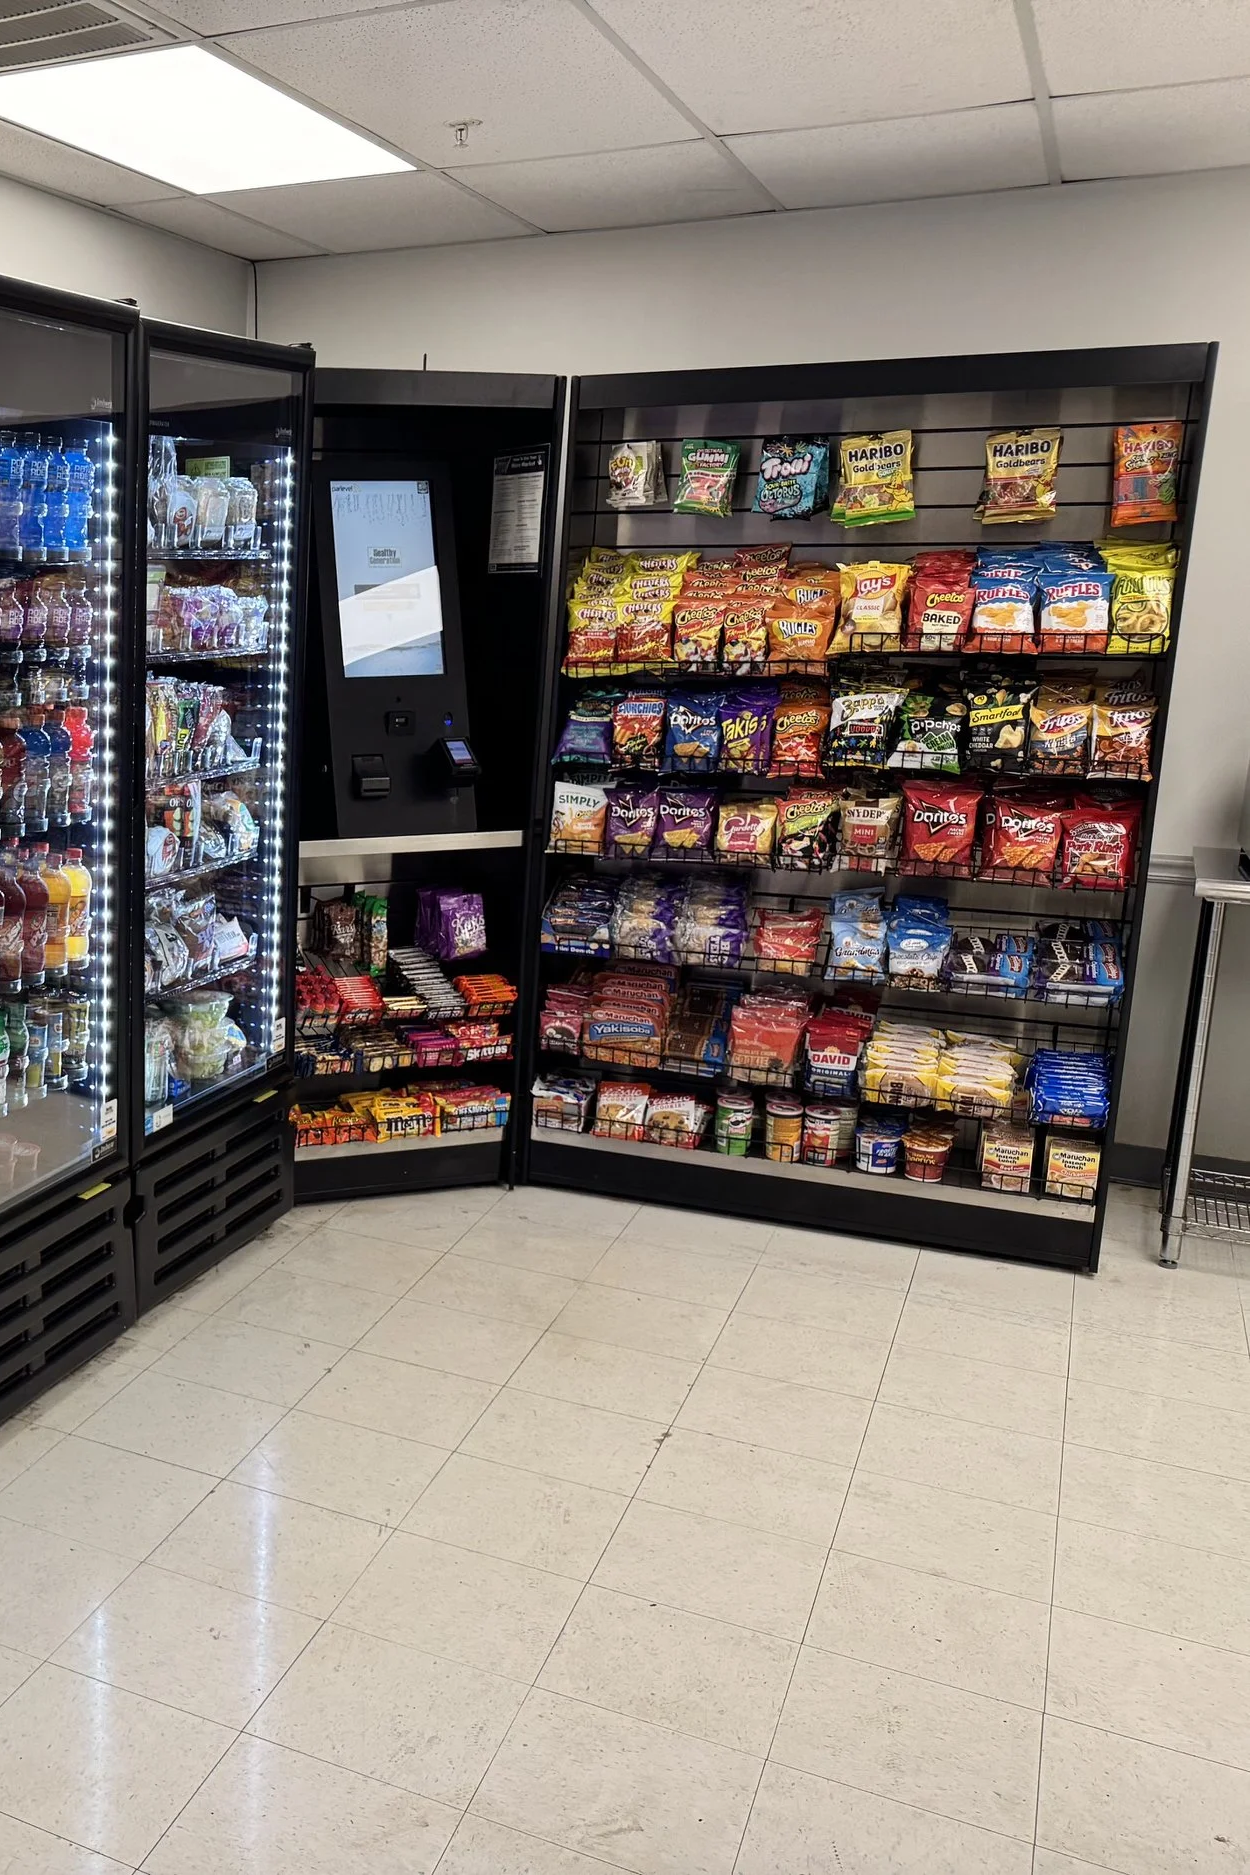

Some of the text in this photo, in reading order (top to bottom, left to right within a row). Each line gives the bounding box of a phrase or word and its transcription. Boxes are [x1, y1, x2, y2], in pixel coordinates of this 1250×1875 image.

[849, 444, 905, 462] HARIBO
[993, 440, 1051, 458] HARIBO
[1123, 439, 1175, 455] HARIBO
[688, 452, 730, 463] GUMMI
[996, 457, 1046, 468] Goldbears
[760, 452, 812, 480] Trolli
[853, 460, 902, 474] Goldbears
[760, 484, 802, 502] OCTOPUS
[373, 548, 396, 558] Healthy
[857, 575, 894, 598] Lay's
[1044, 582, 1101, 603] RUFFLES
[926, 591, 966, 608] Cheetos
[977, 587, 1030, 602] RUFFLES
[675, 606, 719, 627] Cheetos
[724, 606, 766, 628] Cheetos
[922, 612, 962, 625] BAKED
[777, 620, 817, 637] BUGLES
[669, 712, 716, 727] Doritos
[775, 710, 820, 732] Cheetos
[971, 708, 1022, 724] Smartfood
[1039, 712, 1087, 732] Fritos
[721, 714, 759, 744] Takis
[911, 717, 962, 733] popchips
[558, 794, 600, 809] SIMPLY
[611, 806, 655, 818] Doritos
[659, 804, 706, 817] Doritos
[786, 801, 830, 822] Cheetos
[847, 807, 890, 819] SNYDER'S
[913, 810, 968, 826] Doritos
[1000, 815, 1056, 834] Doritos
[853, 827, 874, 836] MINI
[1066, 840, 1124, 854] Pork Rinds
[571, 946, 596, 955] Donuts
[627, 965, 674, 978] Maruchan
[616, 979, 665, 992] Maruchan
[613, 987, 659, 999] Maruchan
[606, 1011, 654, 1025] Maruchan
[594, 1023, 652, 1036] Yakisoba
[733, 1055, 770, 1066] COOKIE
[812, 1054, 851, 1066] DAVID
[811, 1067, 850, 1077] ORIGINAL
[994, 1146, 1029, 1157] Maruchan
[995, 1153, 1021, 1161] Instant
[1060, 1151, 1096, 1163] Maruchan
[1061, 1158, 1087, 1167] Instant
[1063, 1163, 1084, 1171] Lunch
